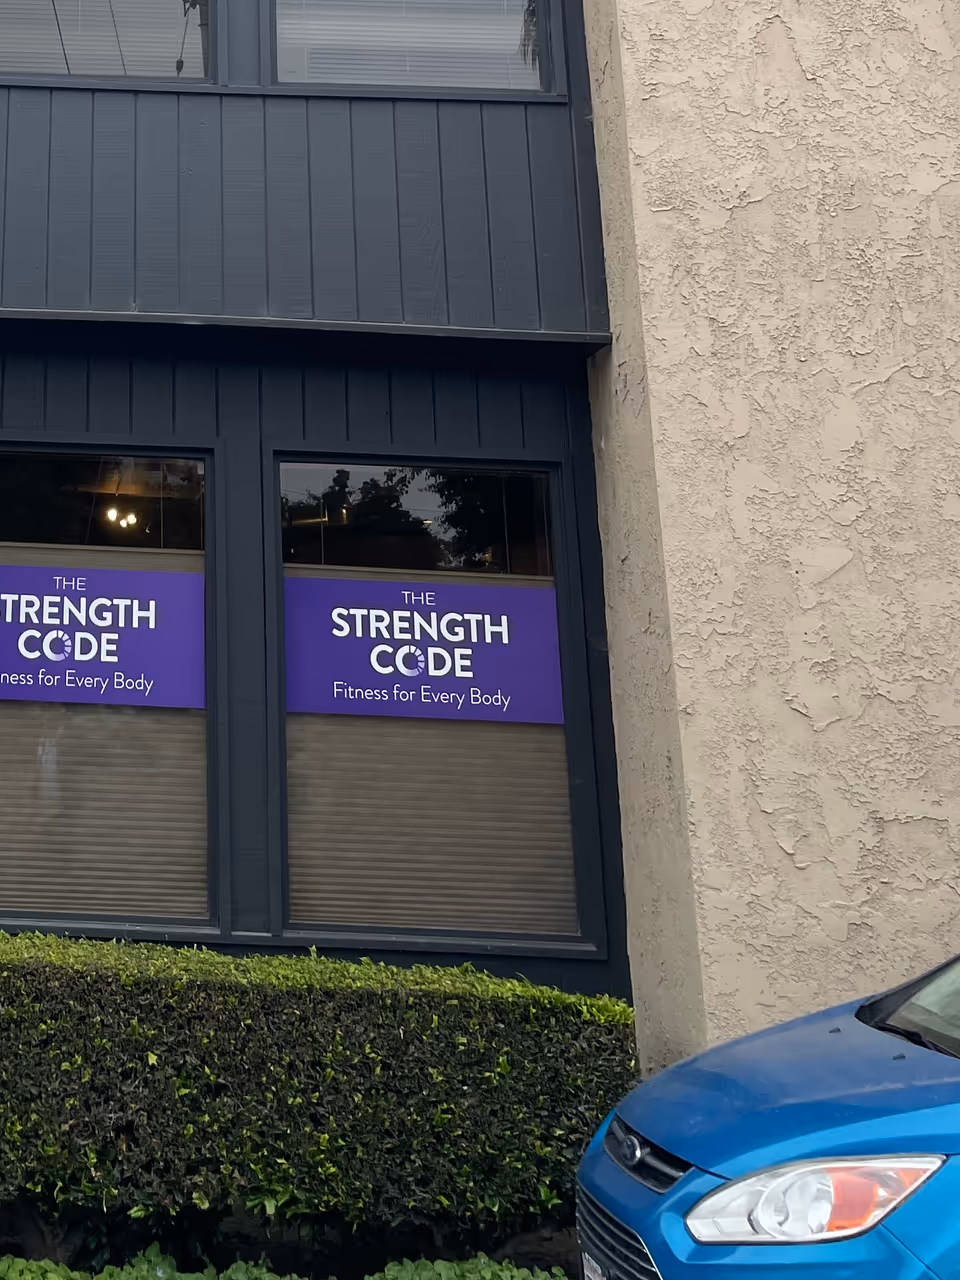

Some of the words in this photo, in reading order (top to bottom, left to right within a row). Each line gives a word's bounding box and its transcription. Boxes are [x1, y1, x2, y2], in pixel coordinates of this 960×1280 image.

[53, 576, 87, 591] THE
[401, 590, 436, 606] THE
[331, 607, 509, 644] STRENGTH
[17, 629, 119, 662] CODE
[369, 644, 474, 678] CODE
[38, 668, 61, 686] for
[65, 670, 109, 694] Every
[114, 672, 154, 696] Body
[333, 681, 389, 701] Fitness
[392, 684, 416, 702] for
[421, 685, 465, 709] Every
[470, 688, 511, 711] Body
